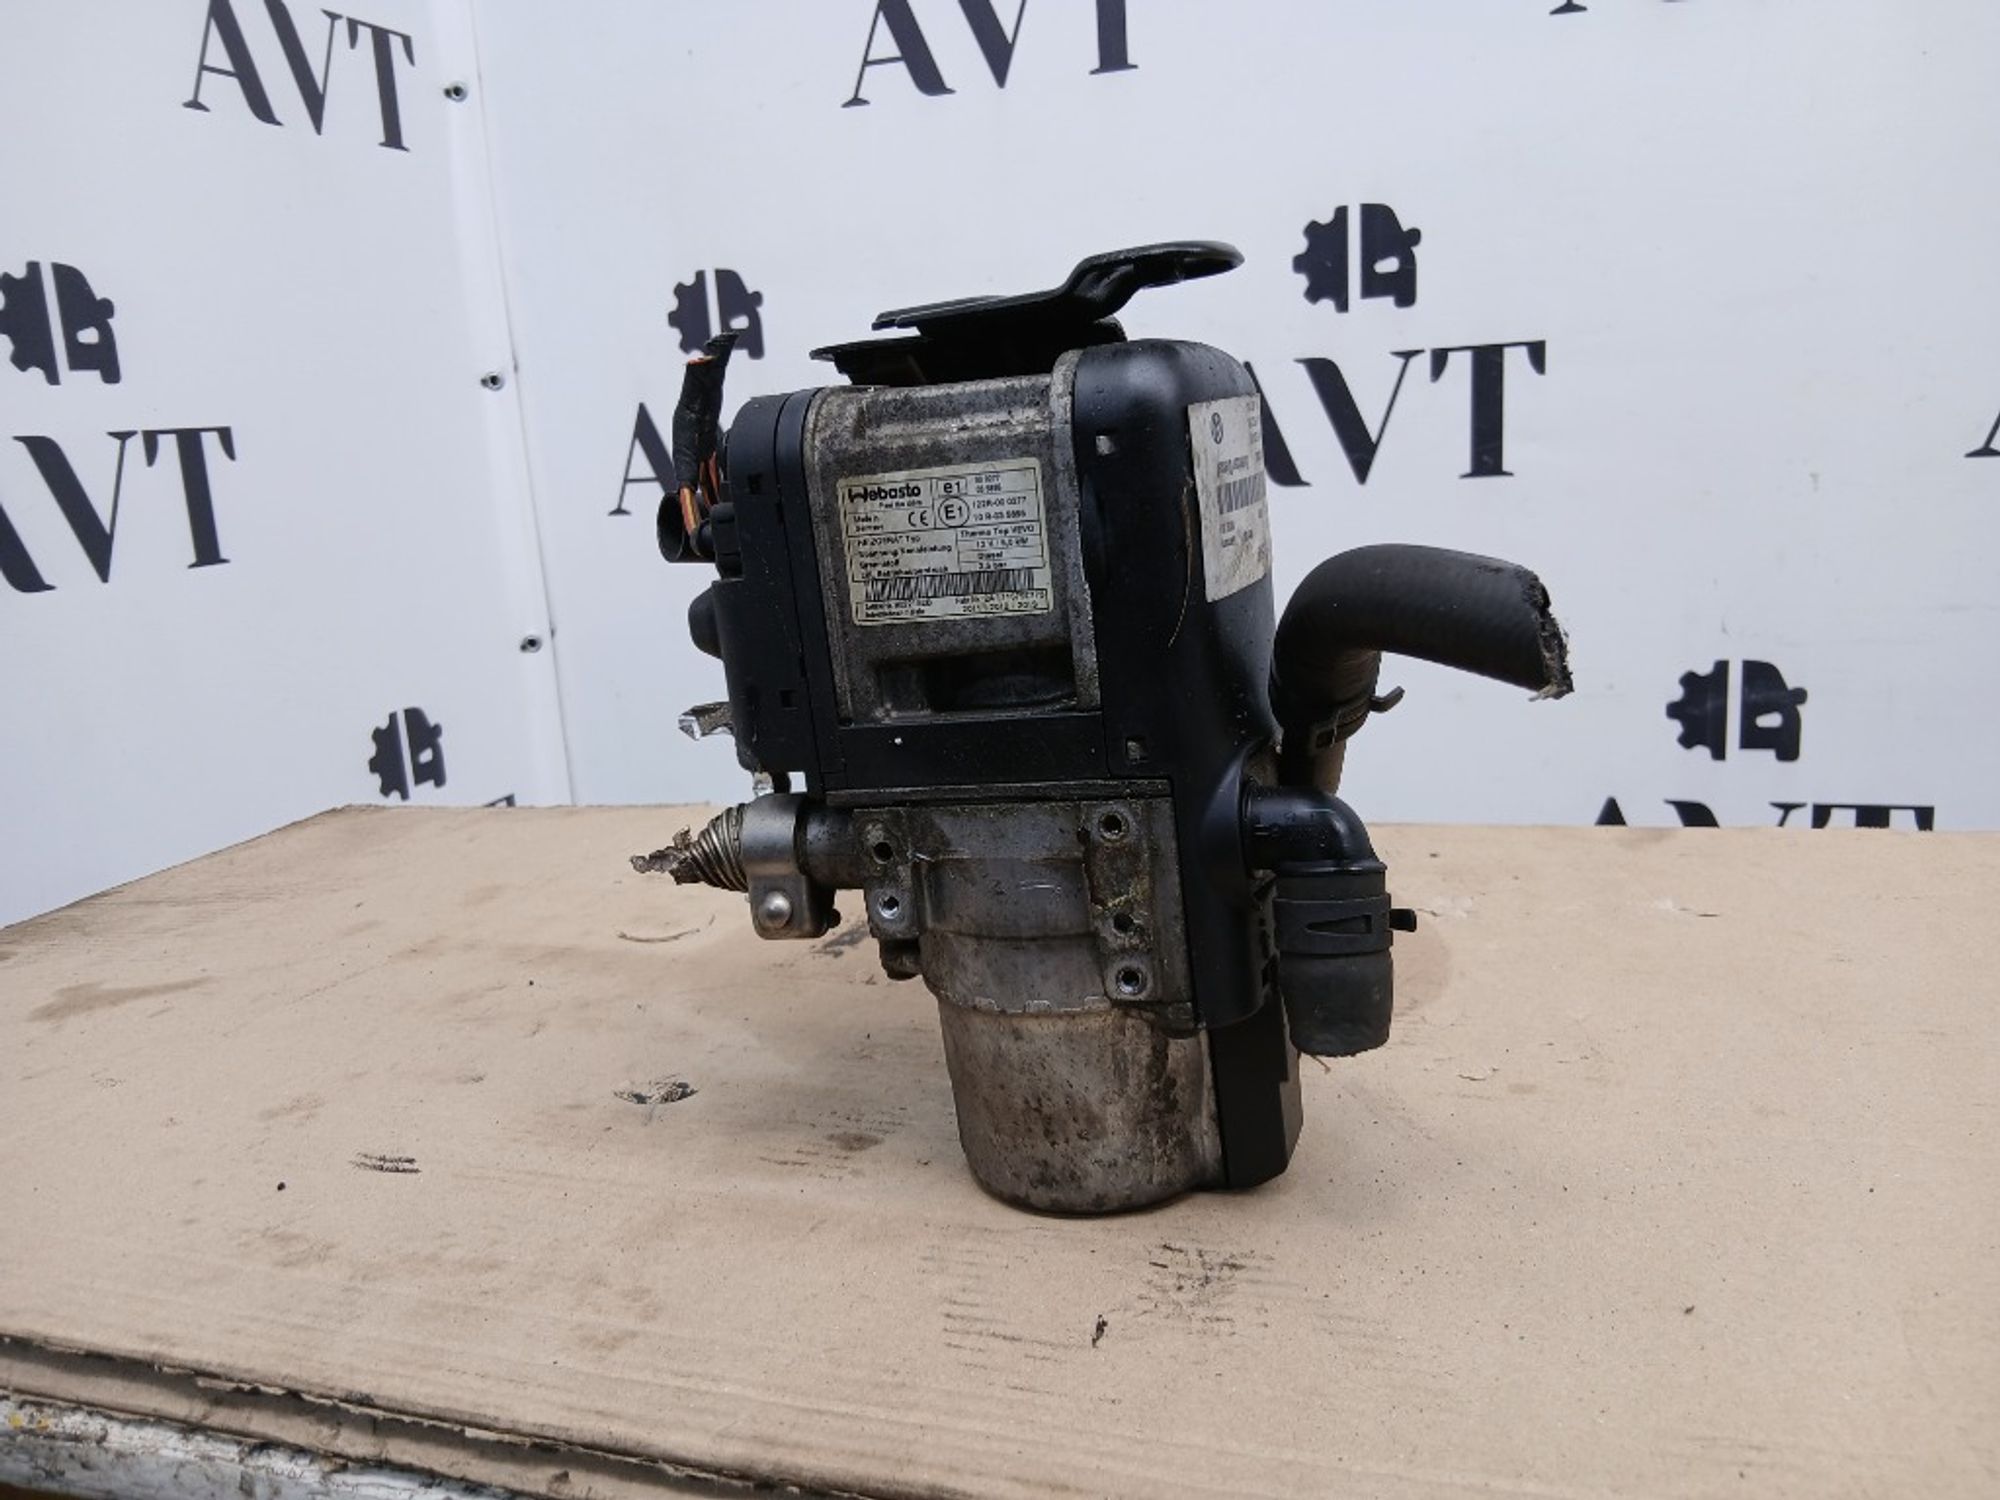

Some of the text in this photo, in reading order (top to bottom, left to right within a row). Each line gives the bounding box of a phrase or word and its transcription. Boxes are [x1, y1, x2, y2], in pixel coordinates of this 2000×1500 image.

[182, 0, 415, 152] AVT
[848, 483, 921, 503] Webasto
[944, 504, 963, 520] E1
